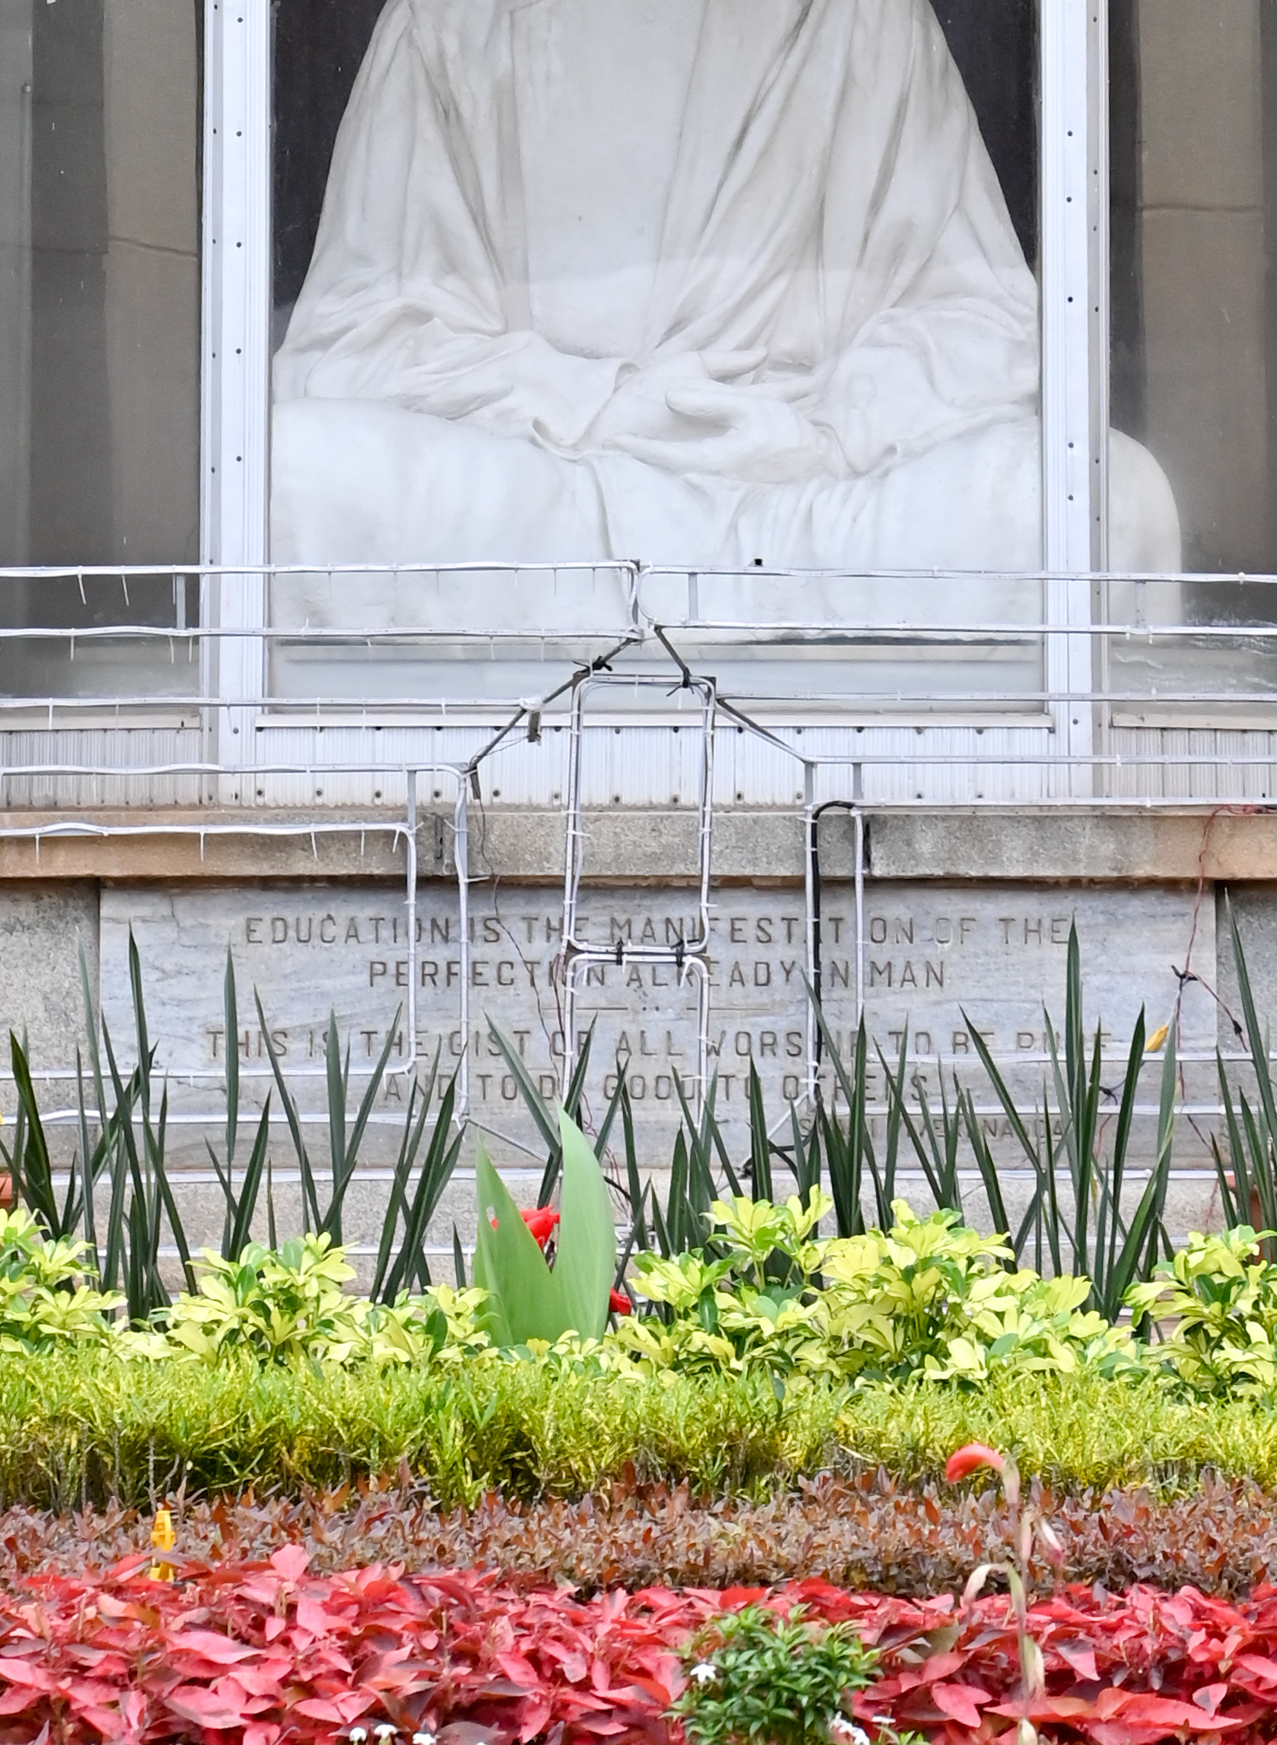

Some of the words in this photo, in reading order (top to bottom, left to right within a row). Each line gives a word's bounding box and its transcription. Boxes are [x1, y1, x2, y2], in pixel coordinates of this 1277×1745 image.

[245, 916, 450, 944] EDUCATION
[468, 917, 501, 943] IS
[521, 917, 589, 944] THE
[610, 917, 914, 944] MANIFESTTON
[936, 917, 977, 944] OF
[998, 917, 1069, 944] THE
[817, 961, 849, 987] N
[869, 961, 944, 988] MAN
[206, 1031, 287, 1057] THIS
[309, 1031, 340, 1057] I
[616, 1031, 684, 1056] ALL
[888, 1031, 931, 1055] TO
[476, 1075, 520, 1100] TO
